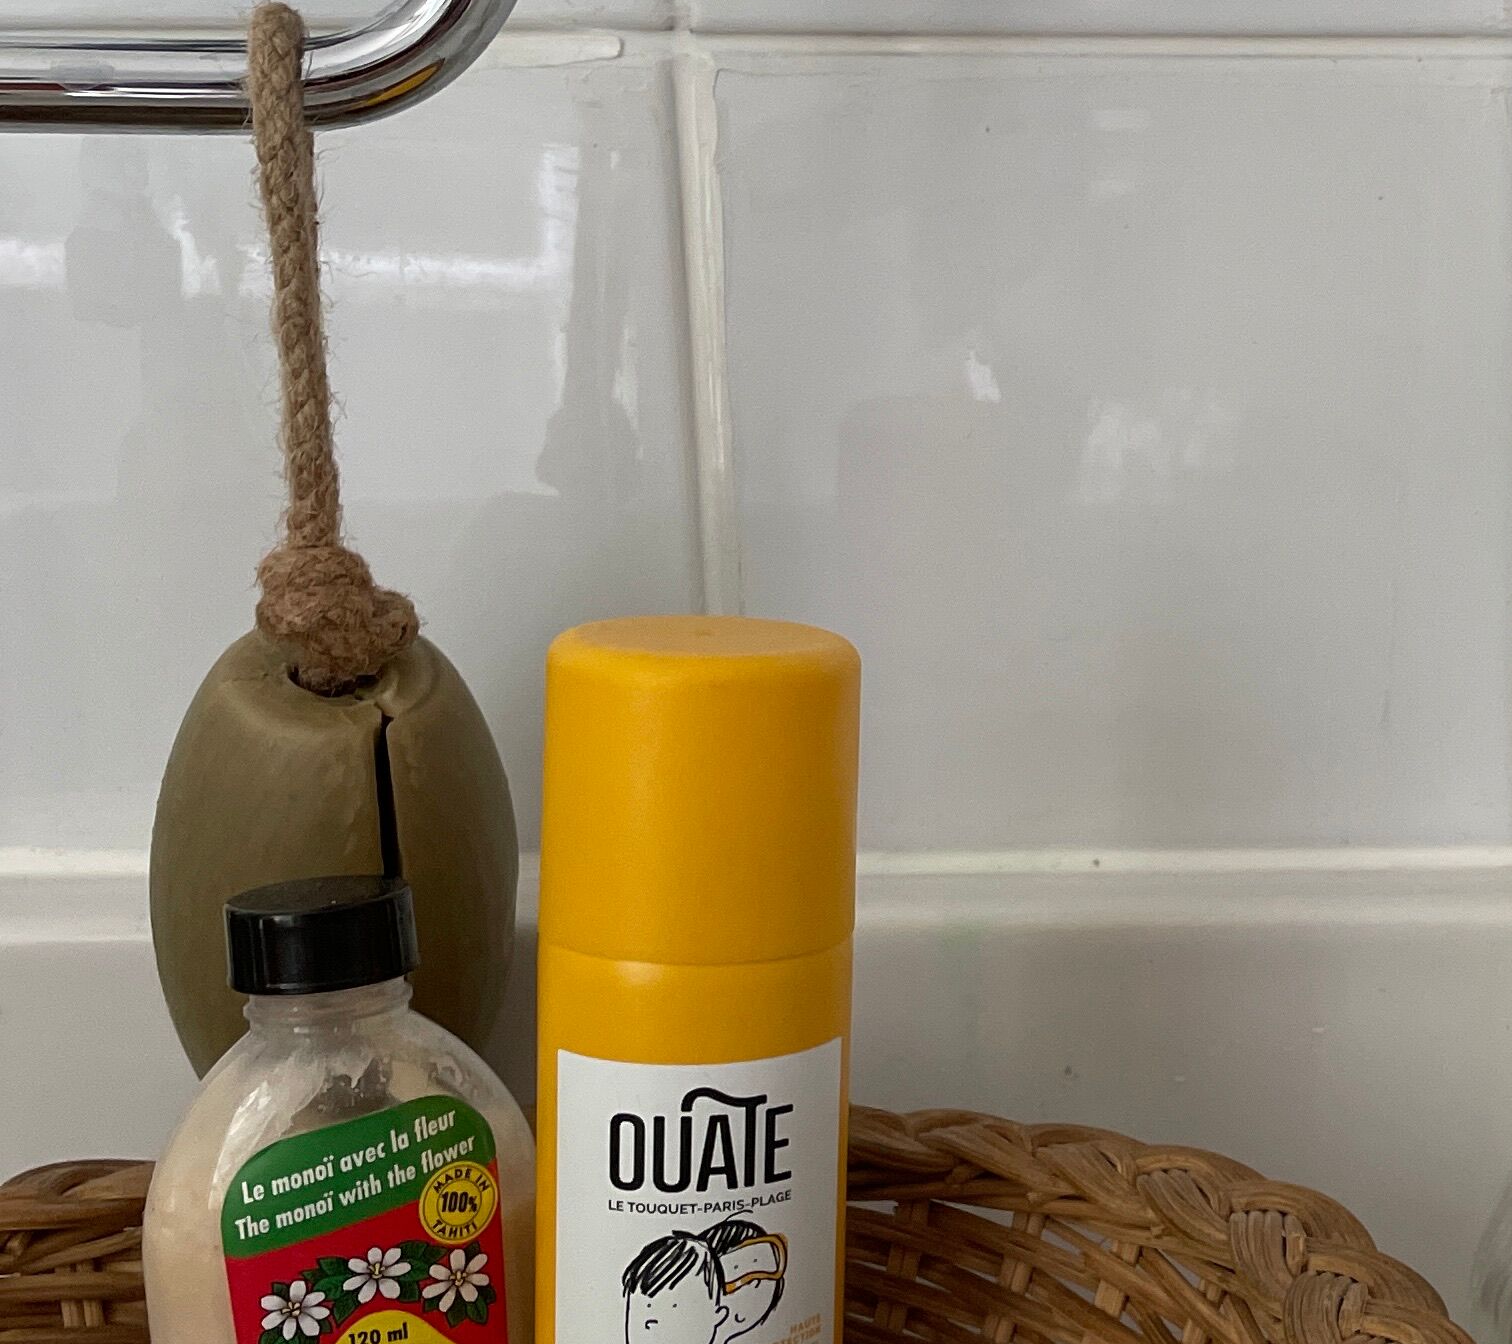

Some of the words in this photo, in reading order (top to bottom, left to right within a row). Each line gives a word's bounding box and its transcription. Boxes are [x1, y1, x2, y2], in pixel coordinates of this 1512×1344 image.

[609, 1087, 794, 1193] OUATE
[241, 1181, 265, 1204] Le
[271, 1155, 334, 1196] monoï
[339, 1142, 386, 1173] avec
[390, 1129, 409, 1153] la
[414, 1109, 456, 1143] fleur
[235, 1215, 270, 1240] The
[275, 1191, 334, 1228] monoï
[338, 1174, 382, 1206] with
[387, 1164, 417, 1189] the
[420, 1135, 476, 1174] flower
[432, 1168, 472, 1193] MADE
[475, 1174, 490, 1193] IN
[441, 1191, 478, 1213] 100%
[608, 1199, 624, 1212] LE
[627, 1189, 792, 1215] TOUQUET-PARIS-PLAGE
[432, 1218, 477, 1238] TAHITI
[387, 1321, 409, 1343] ml
[790, 1313, 821, 1334] HAUTE
